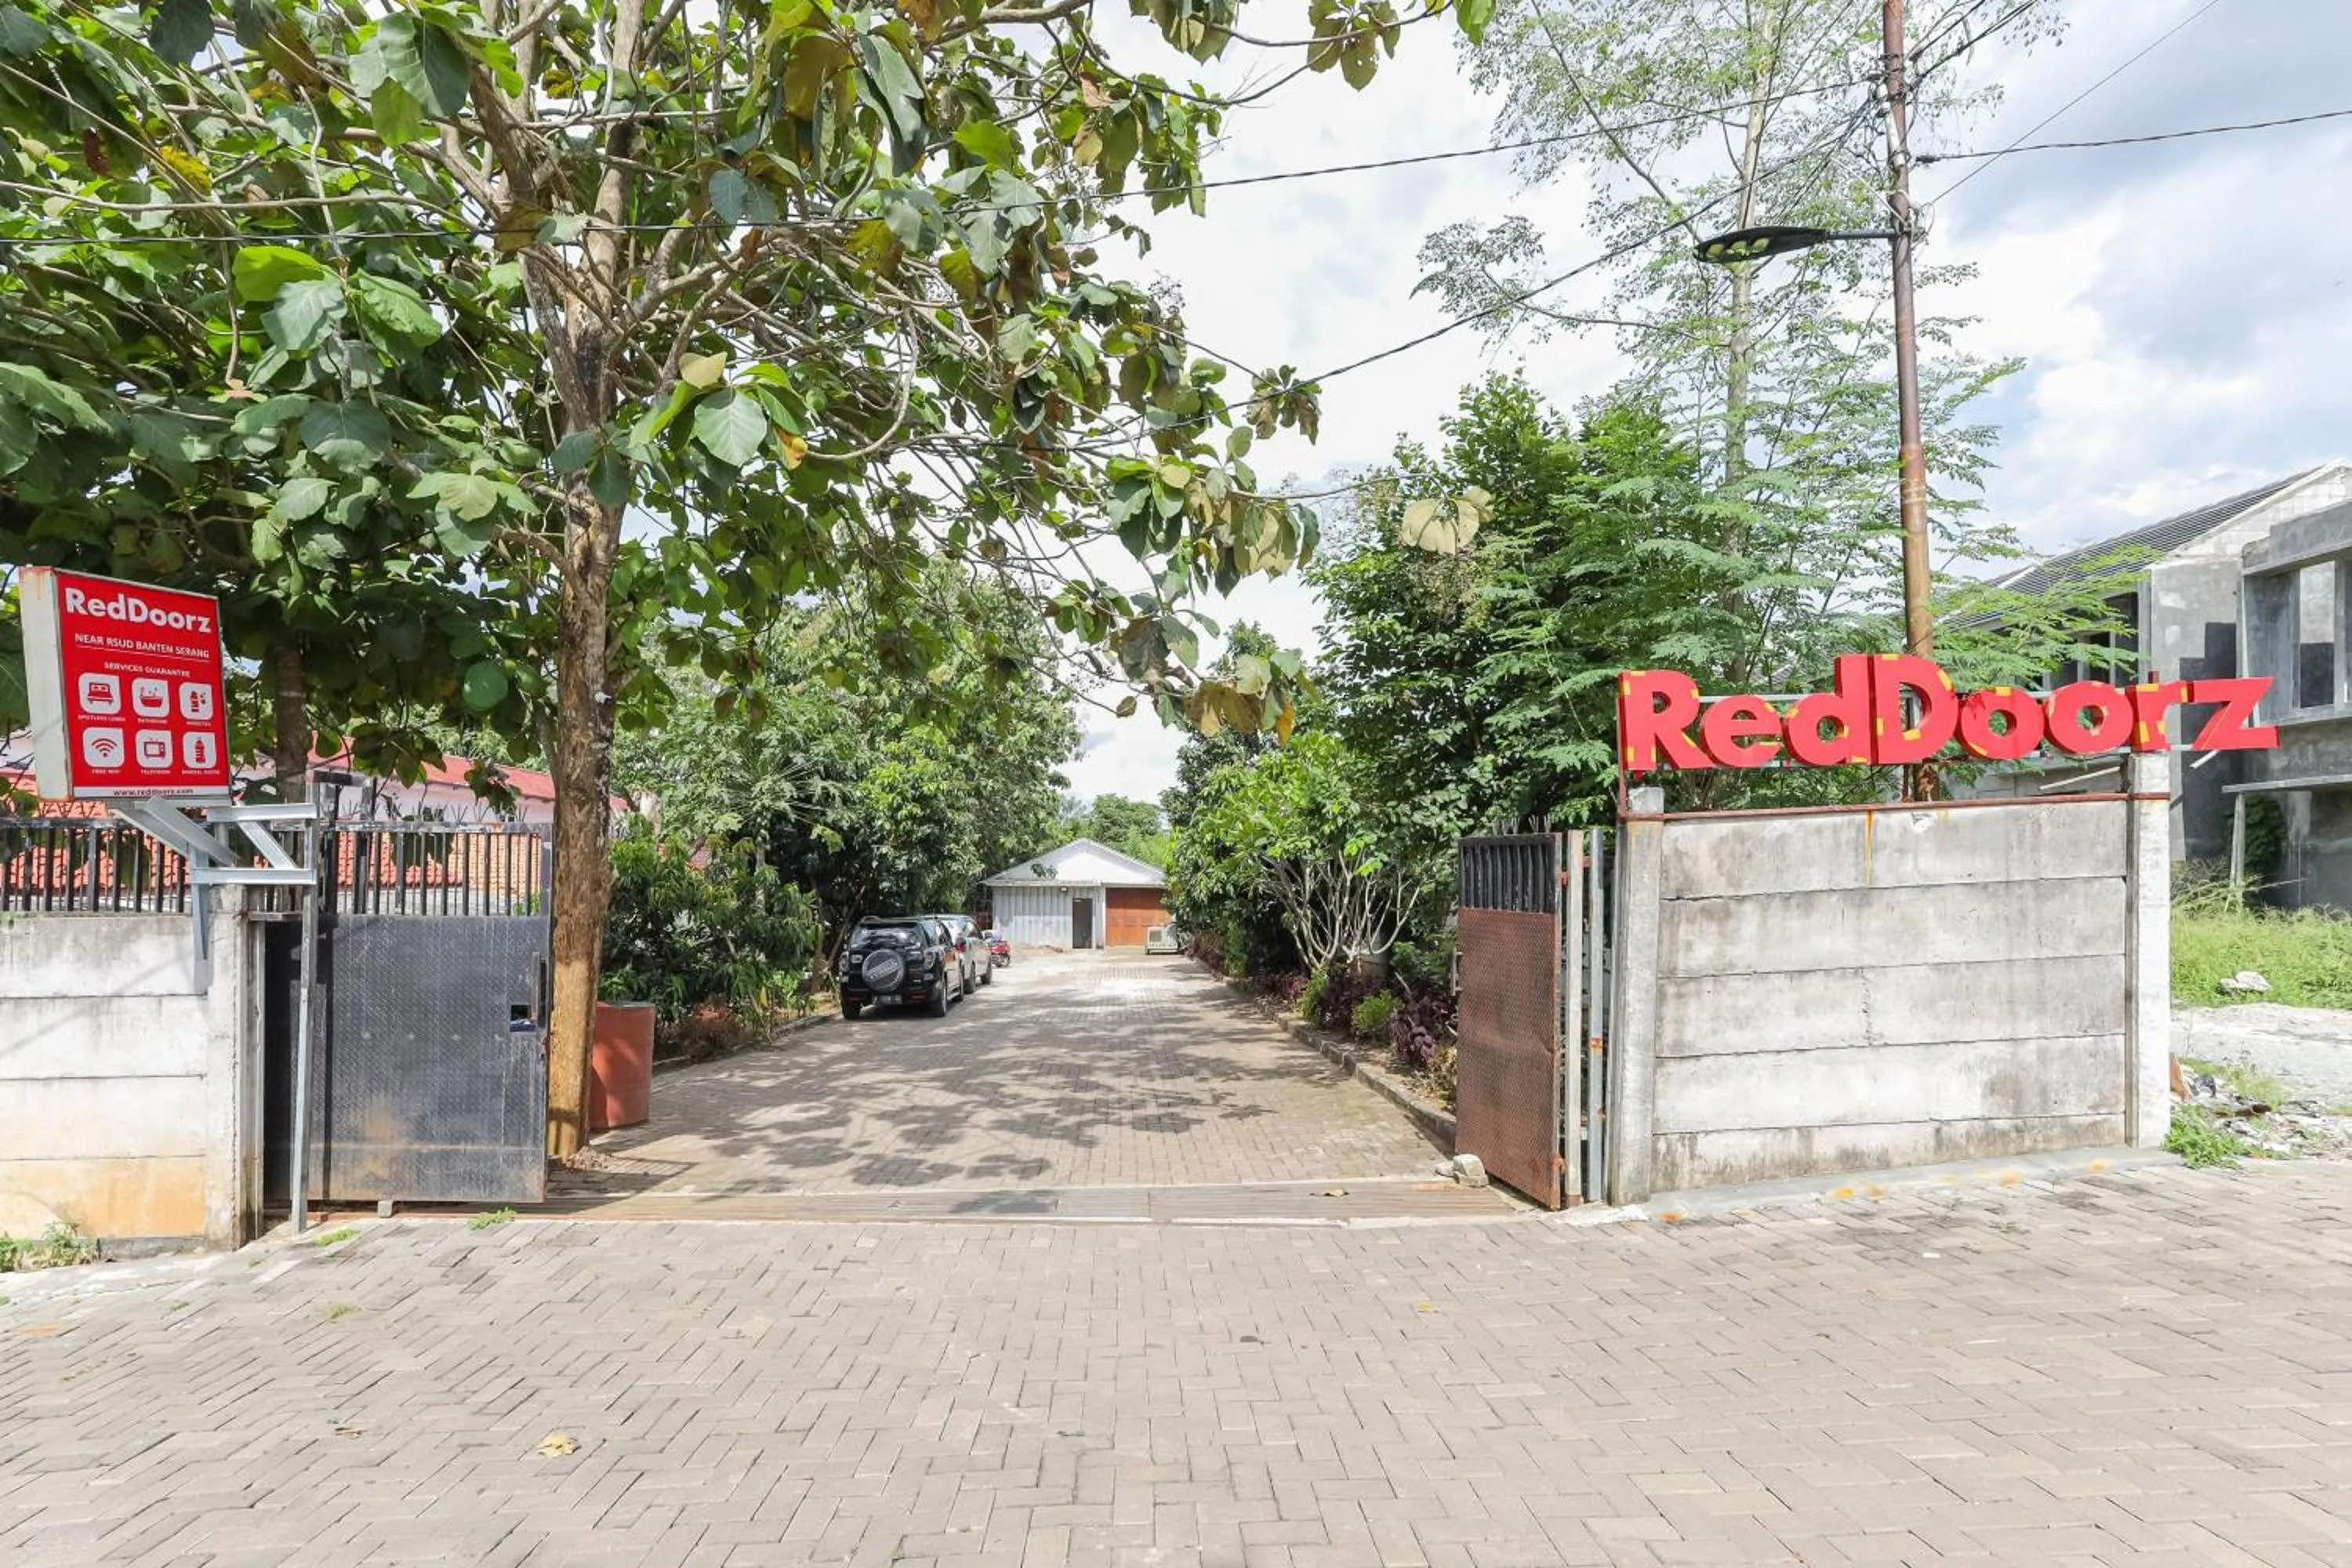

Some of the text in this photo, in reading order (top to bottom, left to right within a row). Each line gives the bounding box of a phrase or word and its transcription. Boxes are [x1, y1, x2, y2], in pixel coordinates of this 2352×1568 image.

[65, 587, 211, 633] RedDoorz
[74, 633, 209, 659] NEAR RSUD BANTEN SERANG
[144, 666, 191, 677] GUARANTEE
[1618, 654, 2281, 771] RedDoorz
